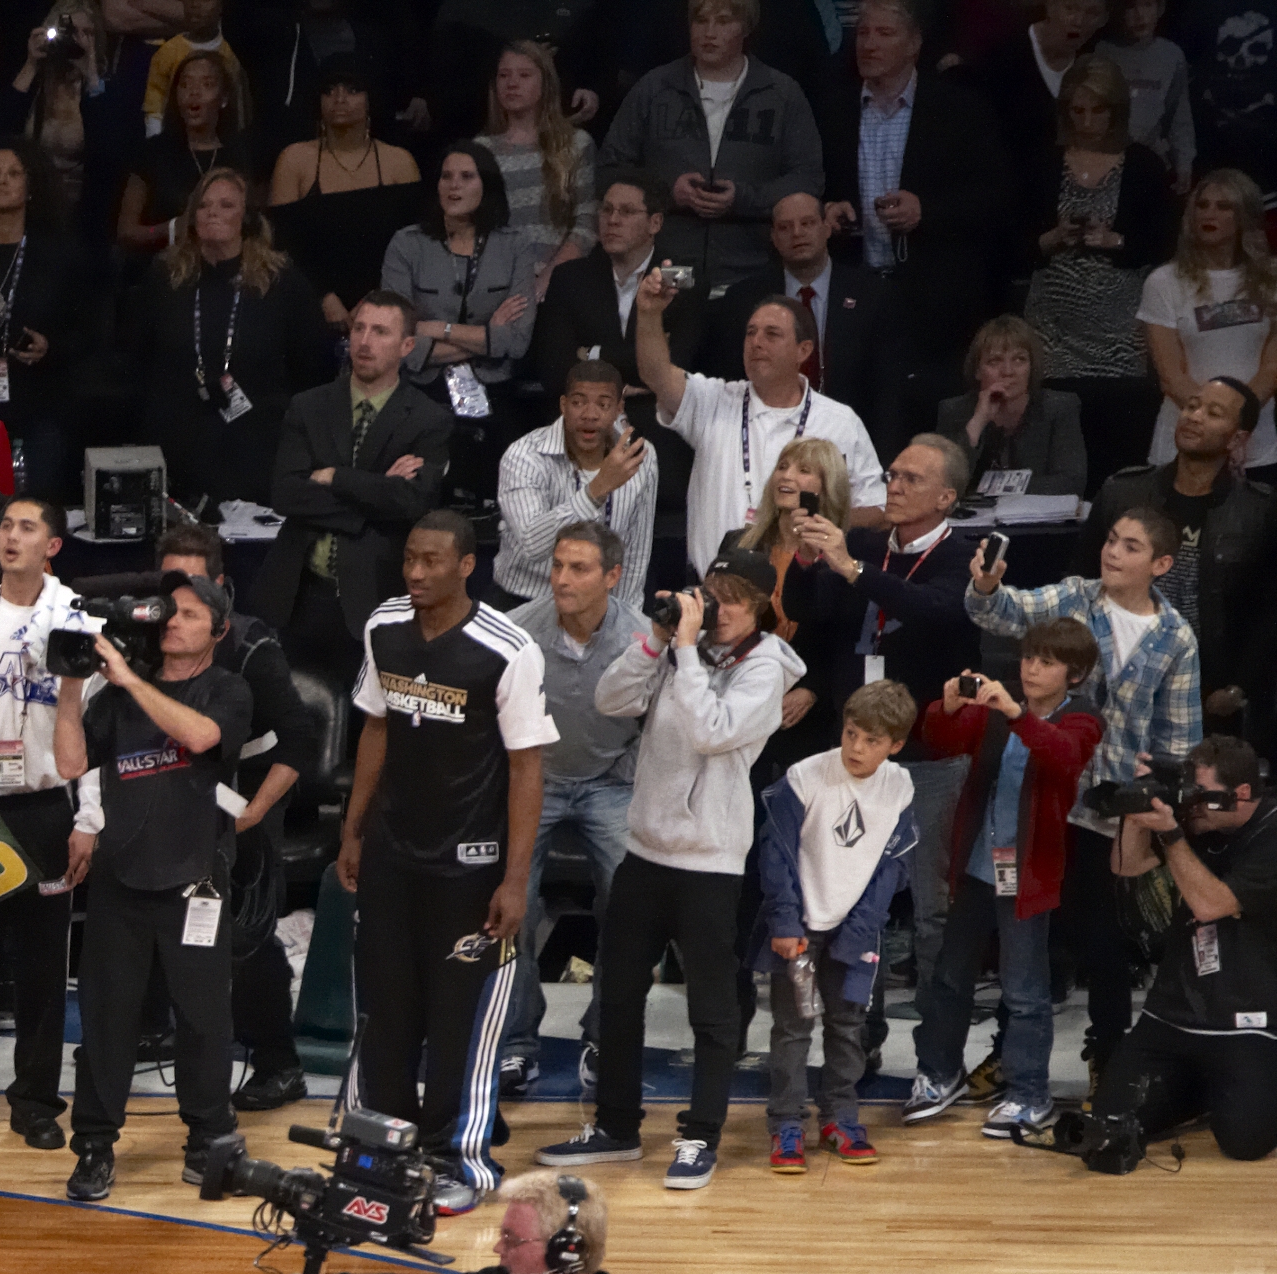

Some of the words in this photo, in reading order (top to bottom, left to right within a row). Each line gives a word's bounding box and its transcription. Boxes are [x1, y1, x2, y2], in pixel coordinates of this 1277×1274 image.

[381, 675, 468, 707] WASHINGTON
[384, 689, 466, 719] ASKETBALL
[342, 1195, 391, 1226] AVS
